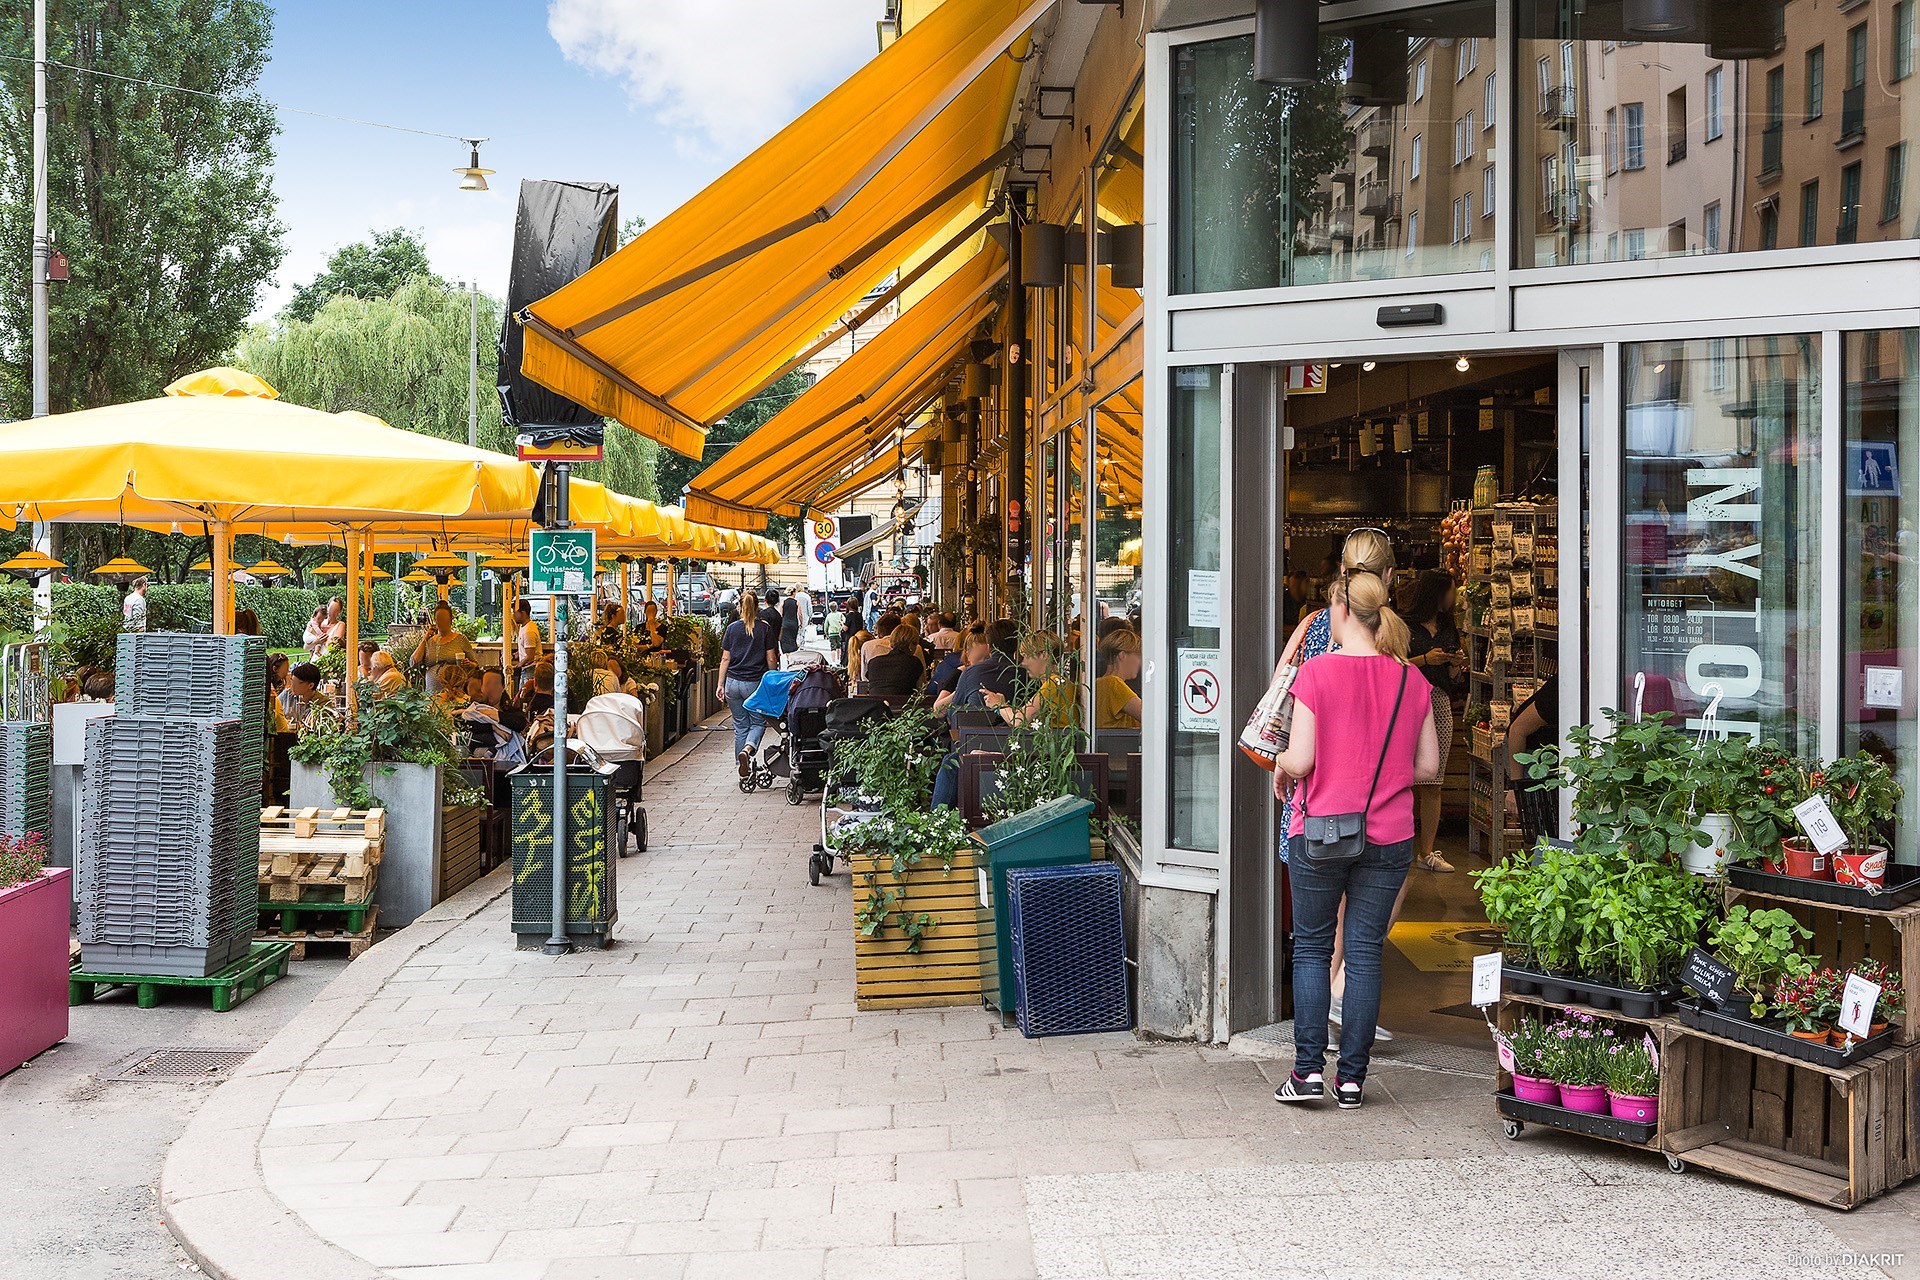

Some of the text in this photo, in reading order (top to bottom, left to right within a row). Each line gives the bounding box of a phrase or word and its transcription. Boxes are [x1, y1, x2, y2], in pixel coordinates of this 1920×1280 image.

[817, 522, 832, 534] 30
[540, 566, 583, 574] Nynäsleden
[1647, 599, 1683, 607] NYTORGET
[1647, 614, 1658, 622] TOR
[1663, 614, 1679, 623] 08.00
[1687, 615, 1703, 624] 24.00
[1647, 624, 1658, 633] LÖR
[1663, 625, 1679, 634] 08.00
[1687, 625, 1703, 635] 01.00
[1811, 818, 1829, 836] 119
[1478, 974, 1490, 990] 45
